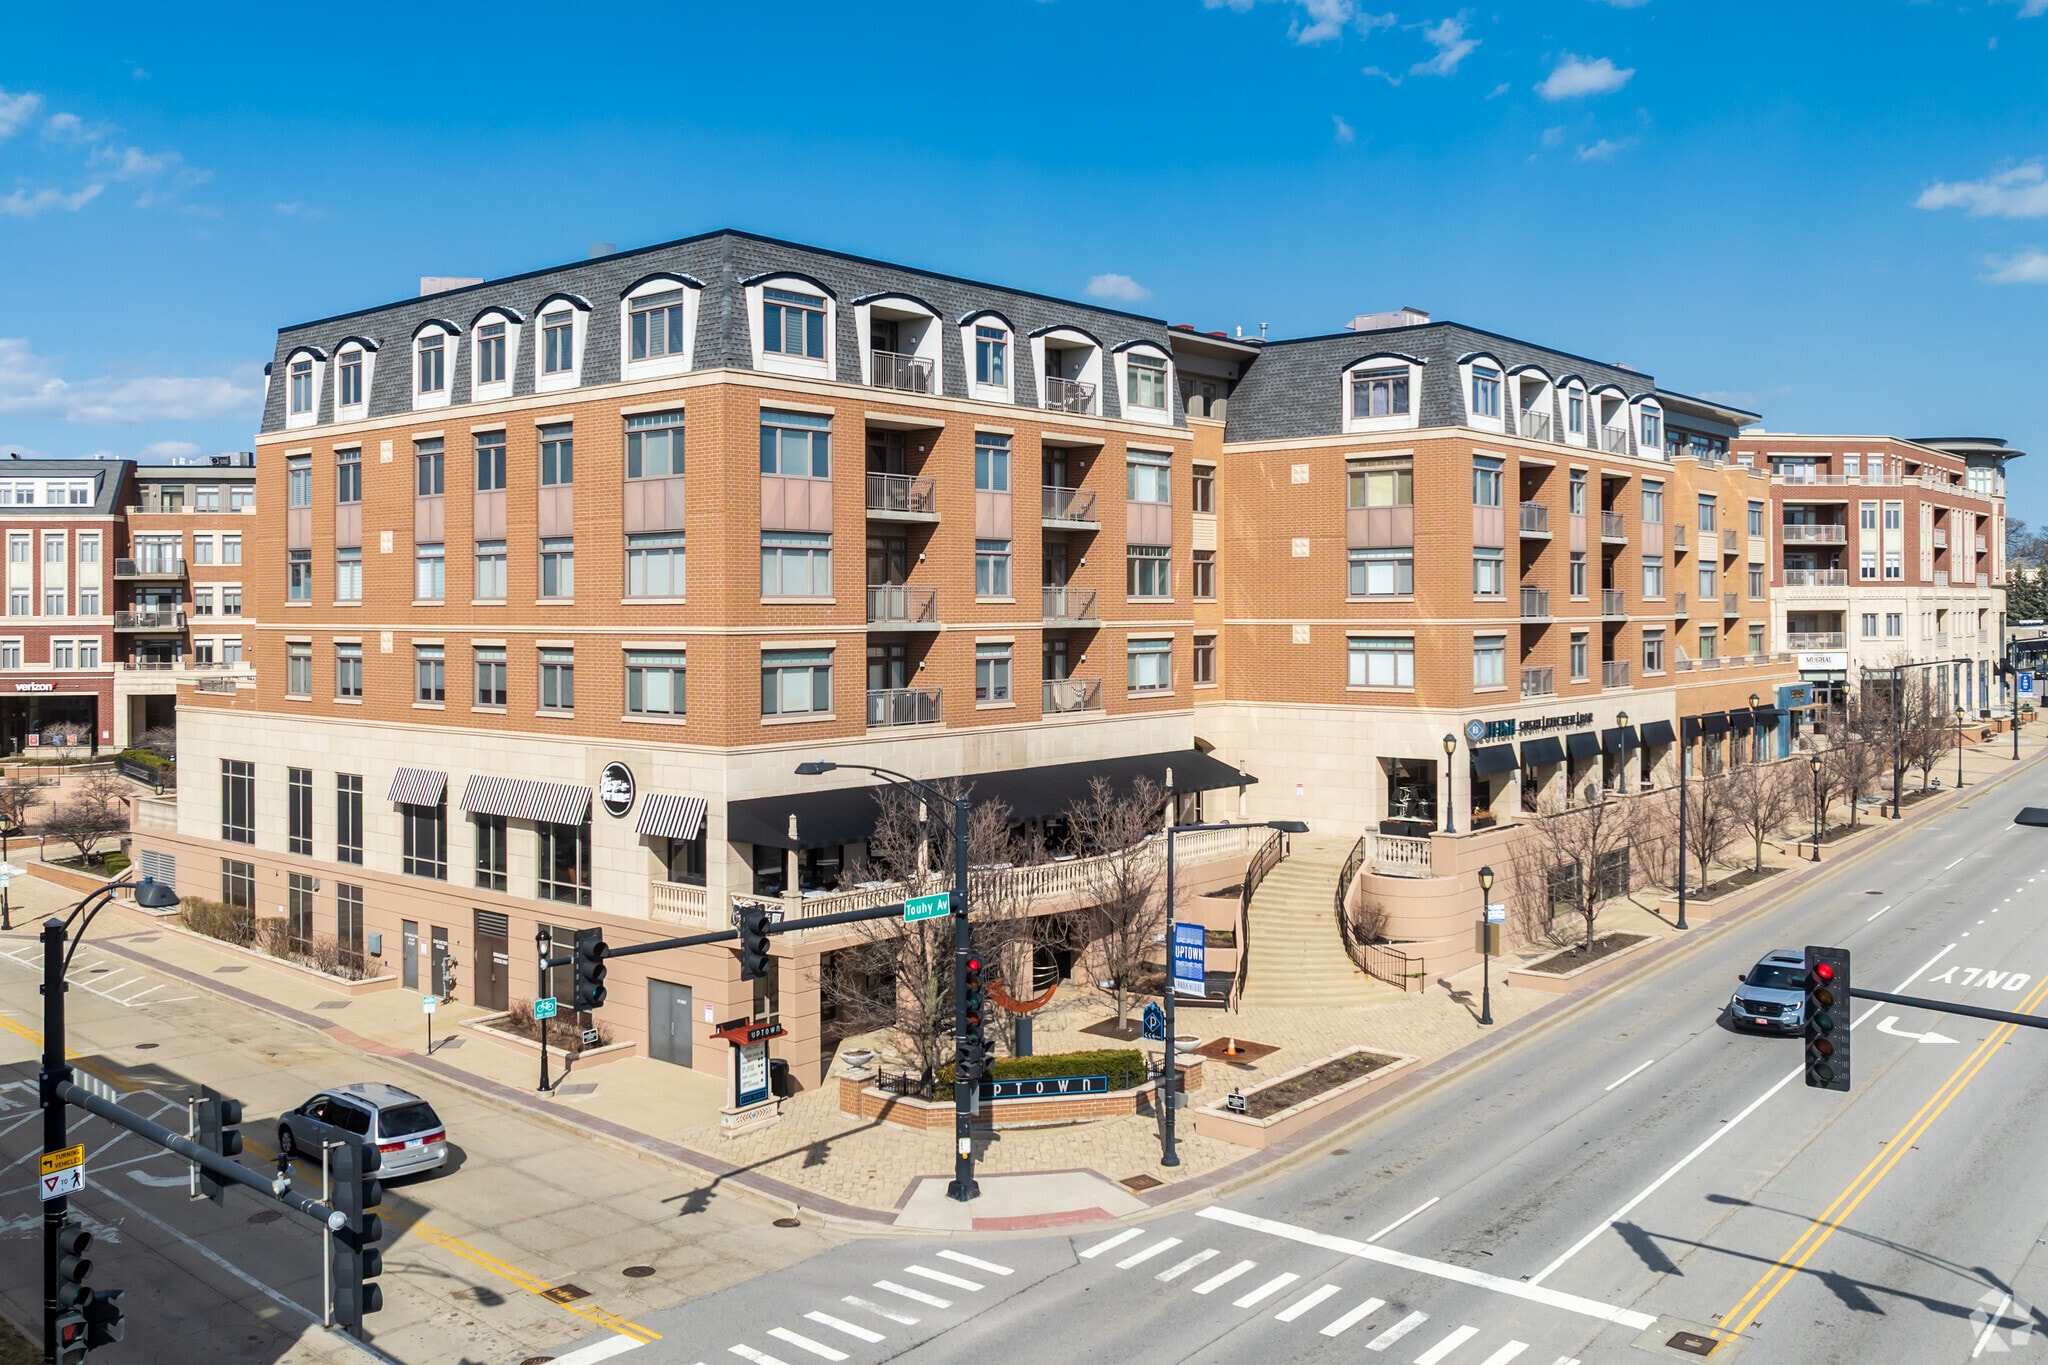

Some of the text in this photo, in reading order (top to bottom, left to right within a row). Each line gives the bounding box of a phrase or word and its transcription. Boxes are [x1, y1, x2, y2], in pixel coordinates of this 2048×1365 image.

[15, 682, 53, 691] verizon
[906, 898, 948, 916] Touhy Av
[1175, 945, 1204, 961] UPTOWN
[1928, 965, 2031, 991] ONLY
[993, 1078, 1091, 1097] PTOWN
[55, 1149, 80, 1160] TURNING
[55, 1157, 81, 1168] VEHICLES
